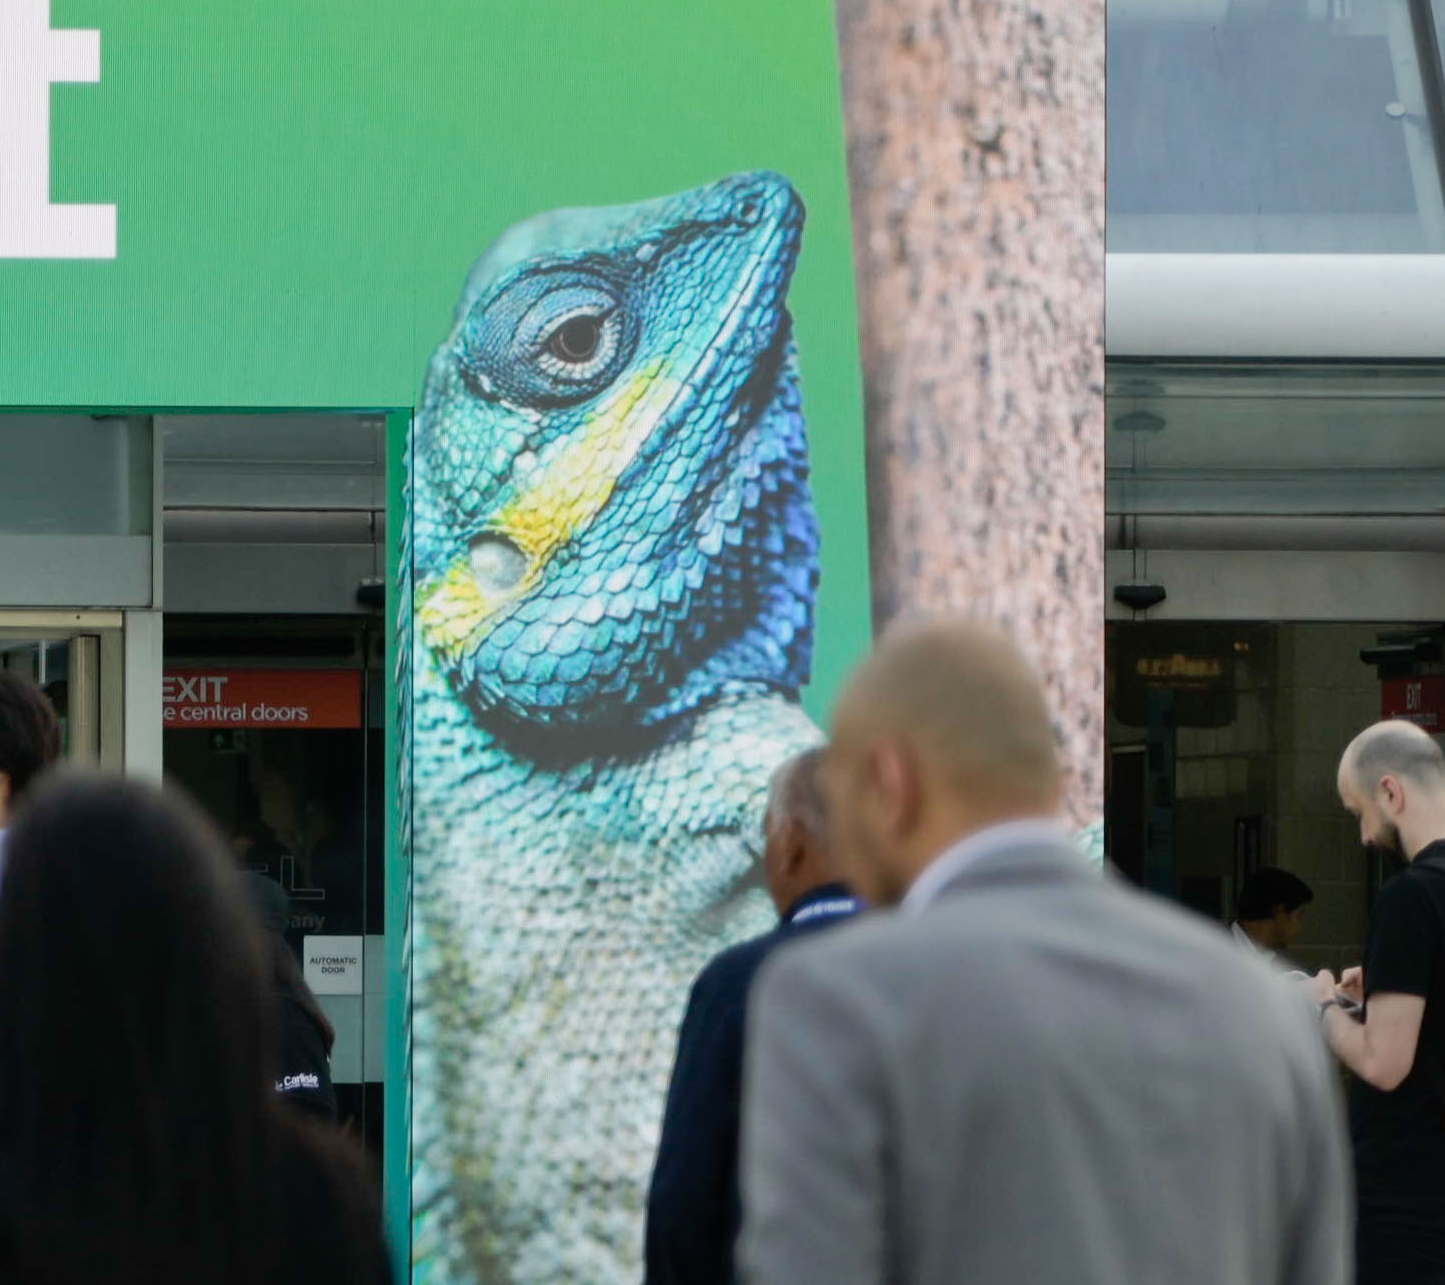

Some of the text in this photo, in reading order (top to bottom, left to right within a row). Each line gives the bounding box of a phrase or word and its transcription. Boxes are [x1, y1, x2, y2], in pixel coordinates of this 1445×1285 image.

[162, 676, 228, 703] EXIT
[180, 702, 247, 722] central
[250, 702, 309, 722] doors
[309, 956, 358, 965] AUTOMATIC
[321, 966, 346, 975] DOOR
